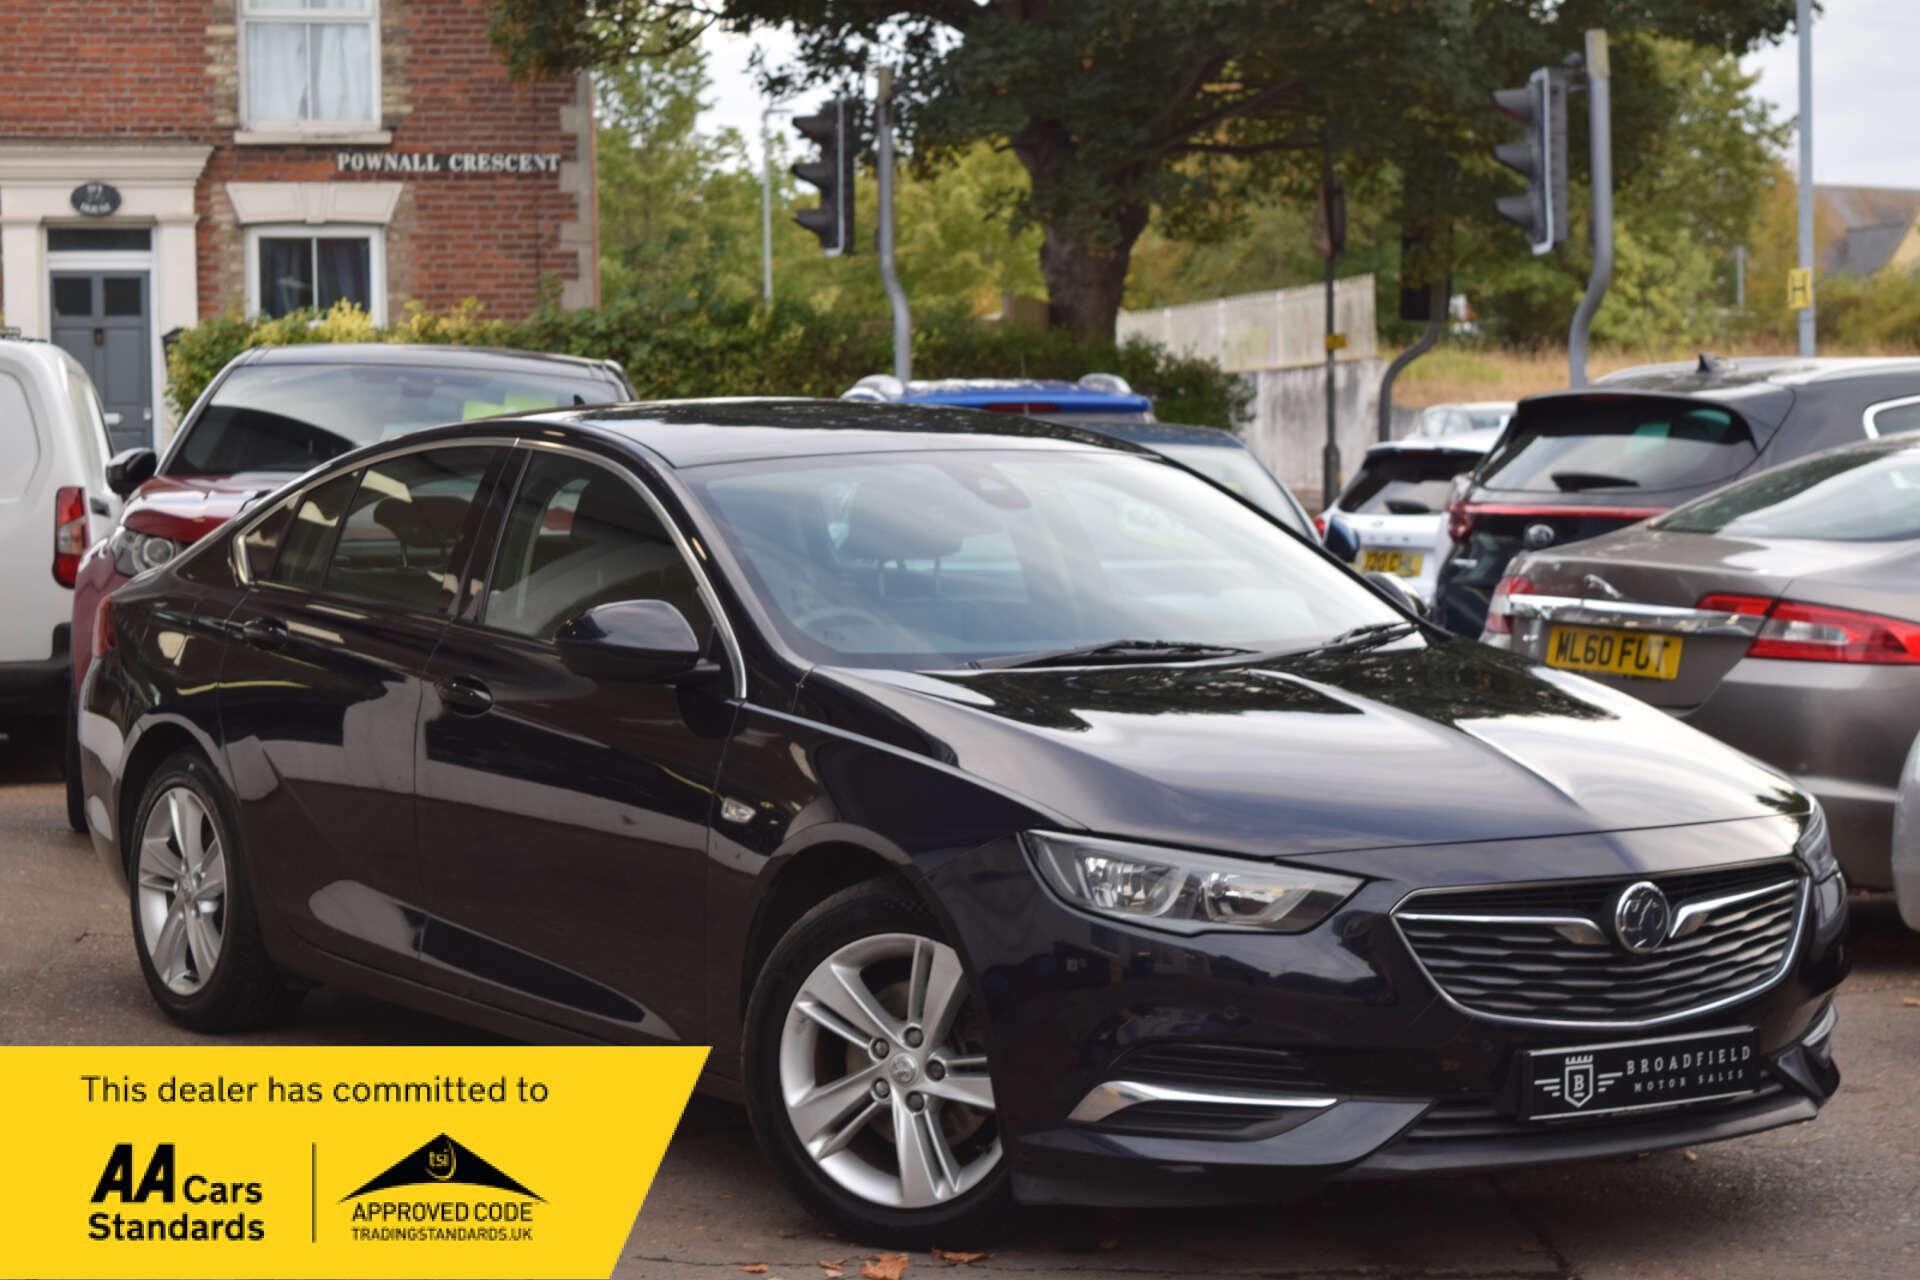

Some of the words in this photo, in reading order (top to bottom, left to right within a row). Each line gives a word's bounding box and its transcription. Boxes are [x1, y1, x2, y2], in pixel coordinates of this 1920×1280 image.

[337, 152, 440, 172] POWNALL
[448, 152, 560, 172] CRESCENT
[1555, 631, 1615, 666] ML60
[1618, 637, 1672, 673] FUT
[1626, 1045, 1751, 1075] BROADFIELD
[1573, 1074, 1585, 1092] B
[1633, 1076, 1687, 1093] MOTOR
[1697, 1069, 1745, 1085] SALES
